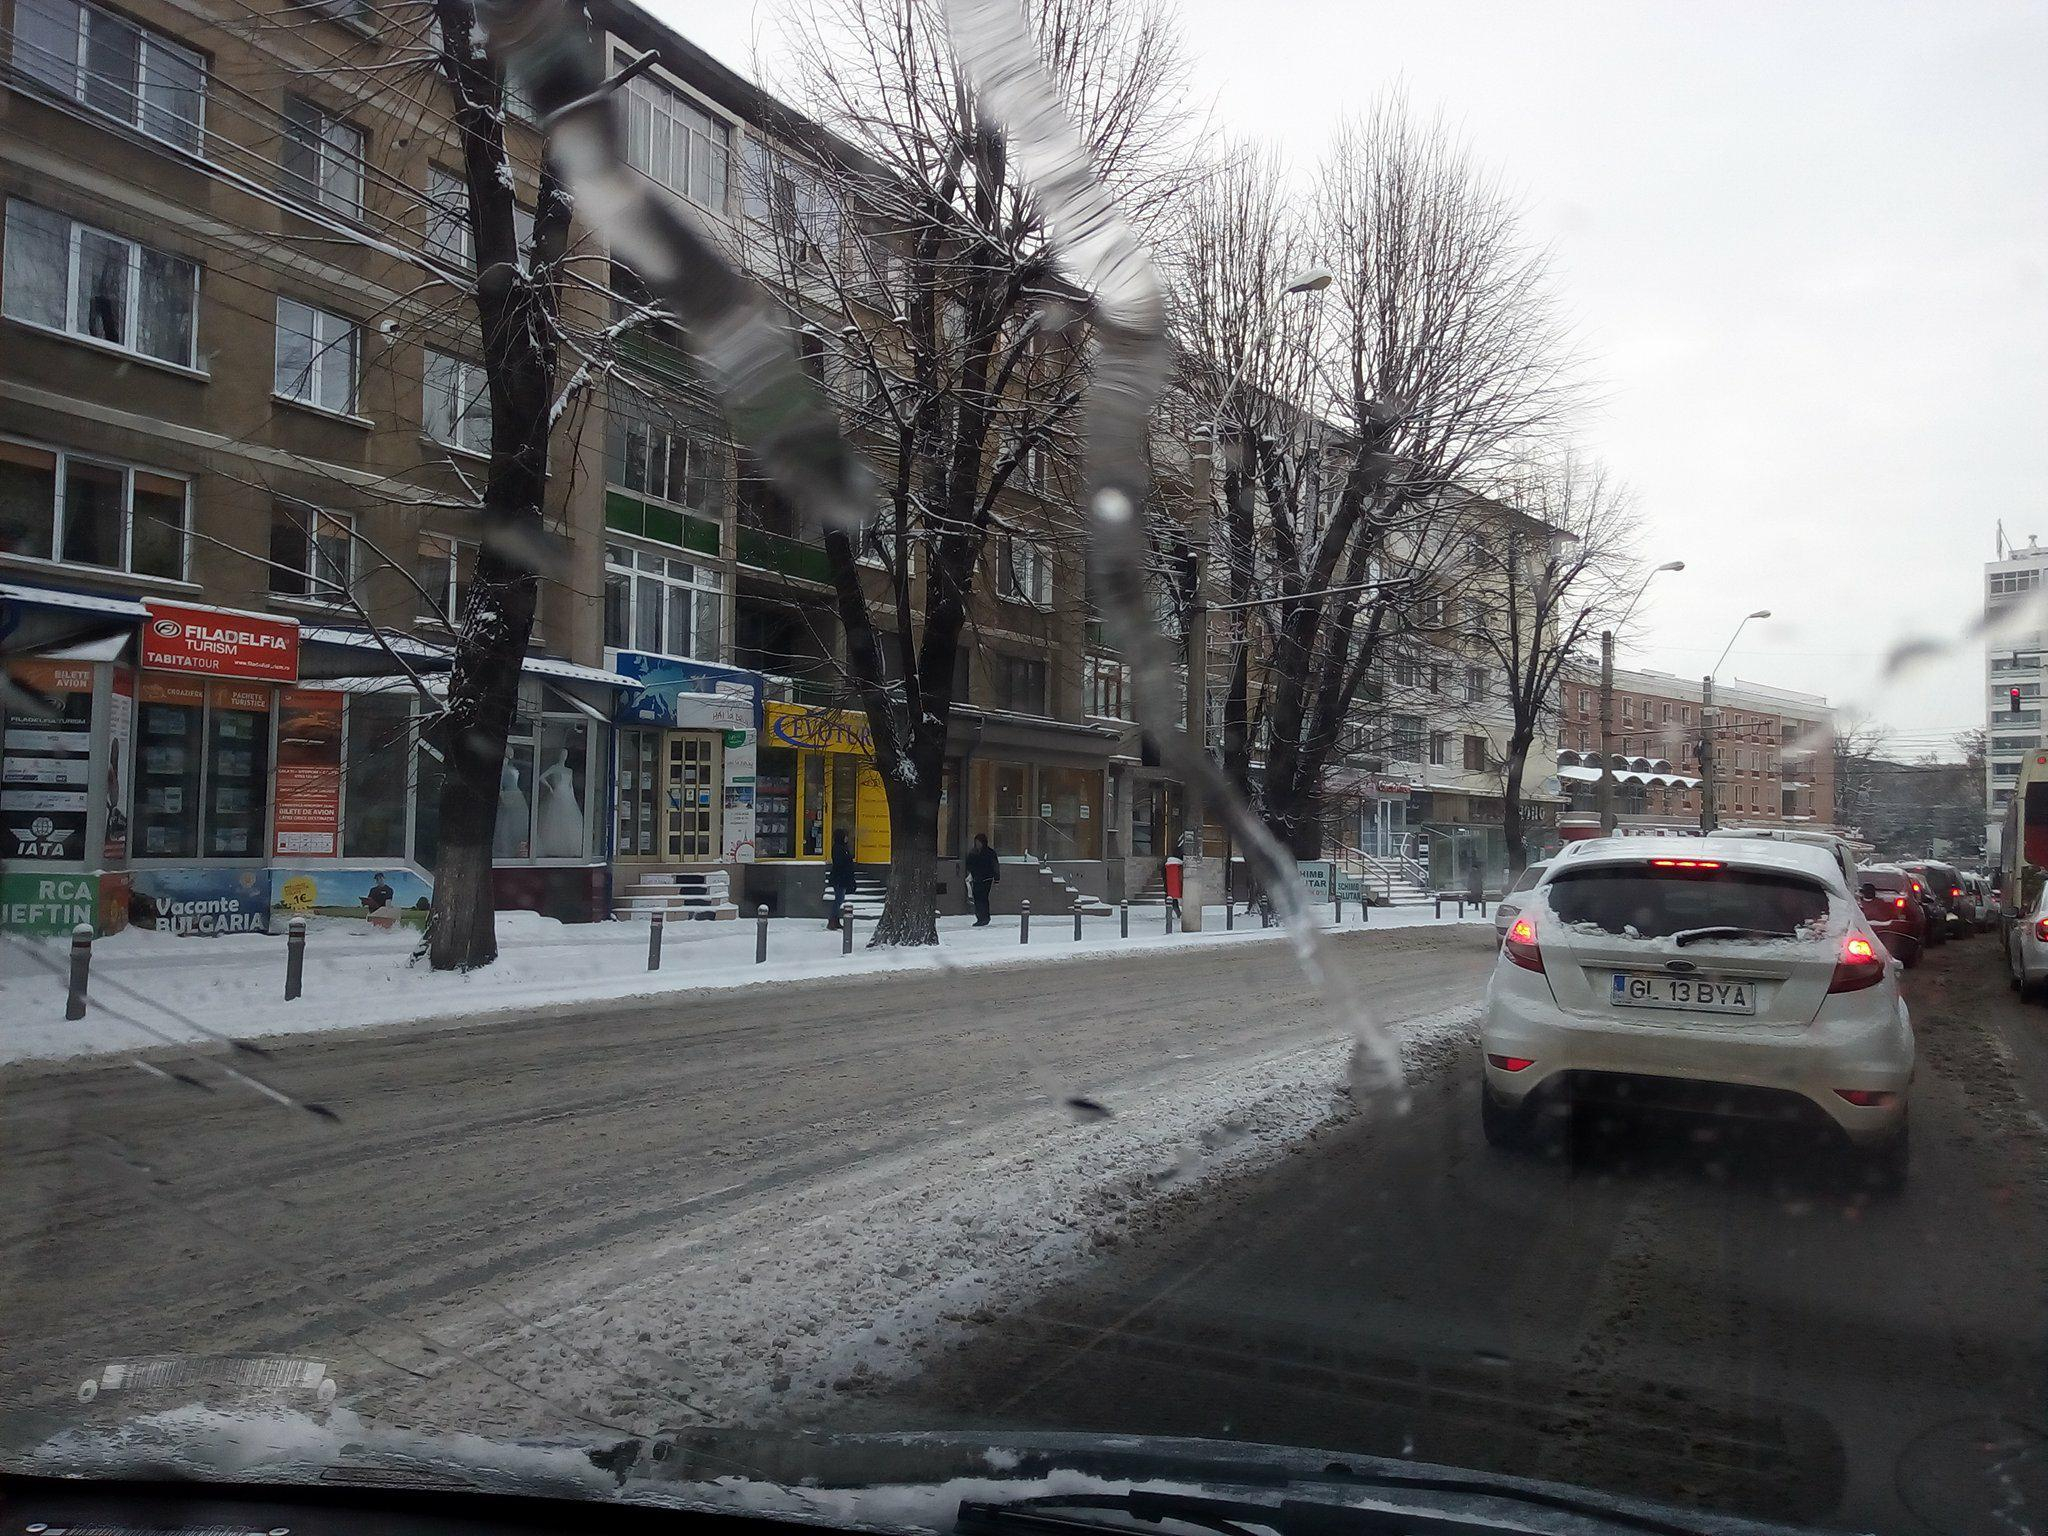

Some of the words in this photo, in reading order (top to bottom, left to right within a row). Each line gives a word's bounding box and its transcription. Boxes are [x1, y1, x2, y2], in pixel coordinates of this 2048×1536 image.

[185, 625, 287, 650] FILADELFIA
[185, 639, 238, 655] TURISM
[147, 652, 220, 669] TABITATOUR
[56, 679, 88, 688] AVION
[17, 842, 65, 856] IATA
[1301, 870, 1324, 878] HIMB
[39, 880, 92, 901] RCA
[1339, 892, 1361, 900] LUTAR
[155, 897, 240, 916] Vacante
[156, 912, 267, 933] BULGARIA
[1630, 980, 1659, 1000] GL
[1669, 981, 1691, 1002] 13
[1697, 983, 1746, 1006] BYA
